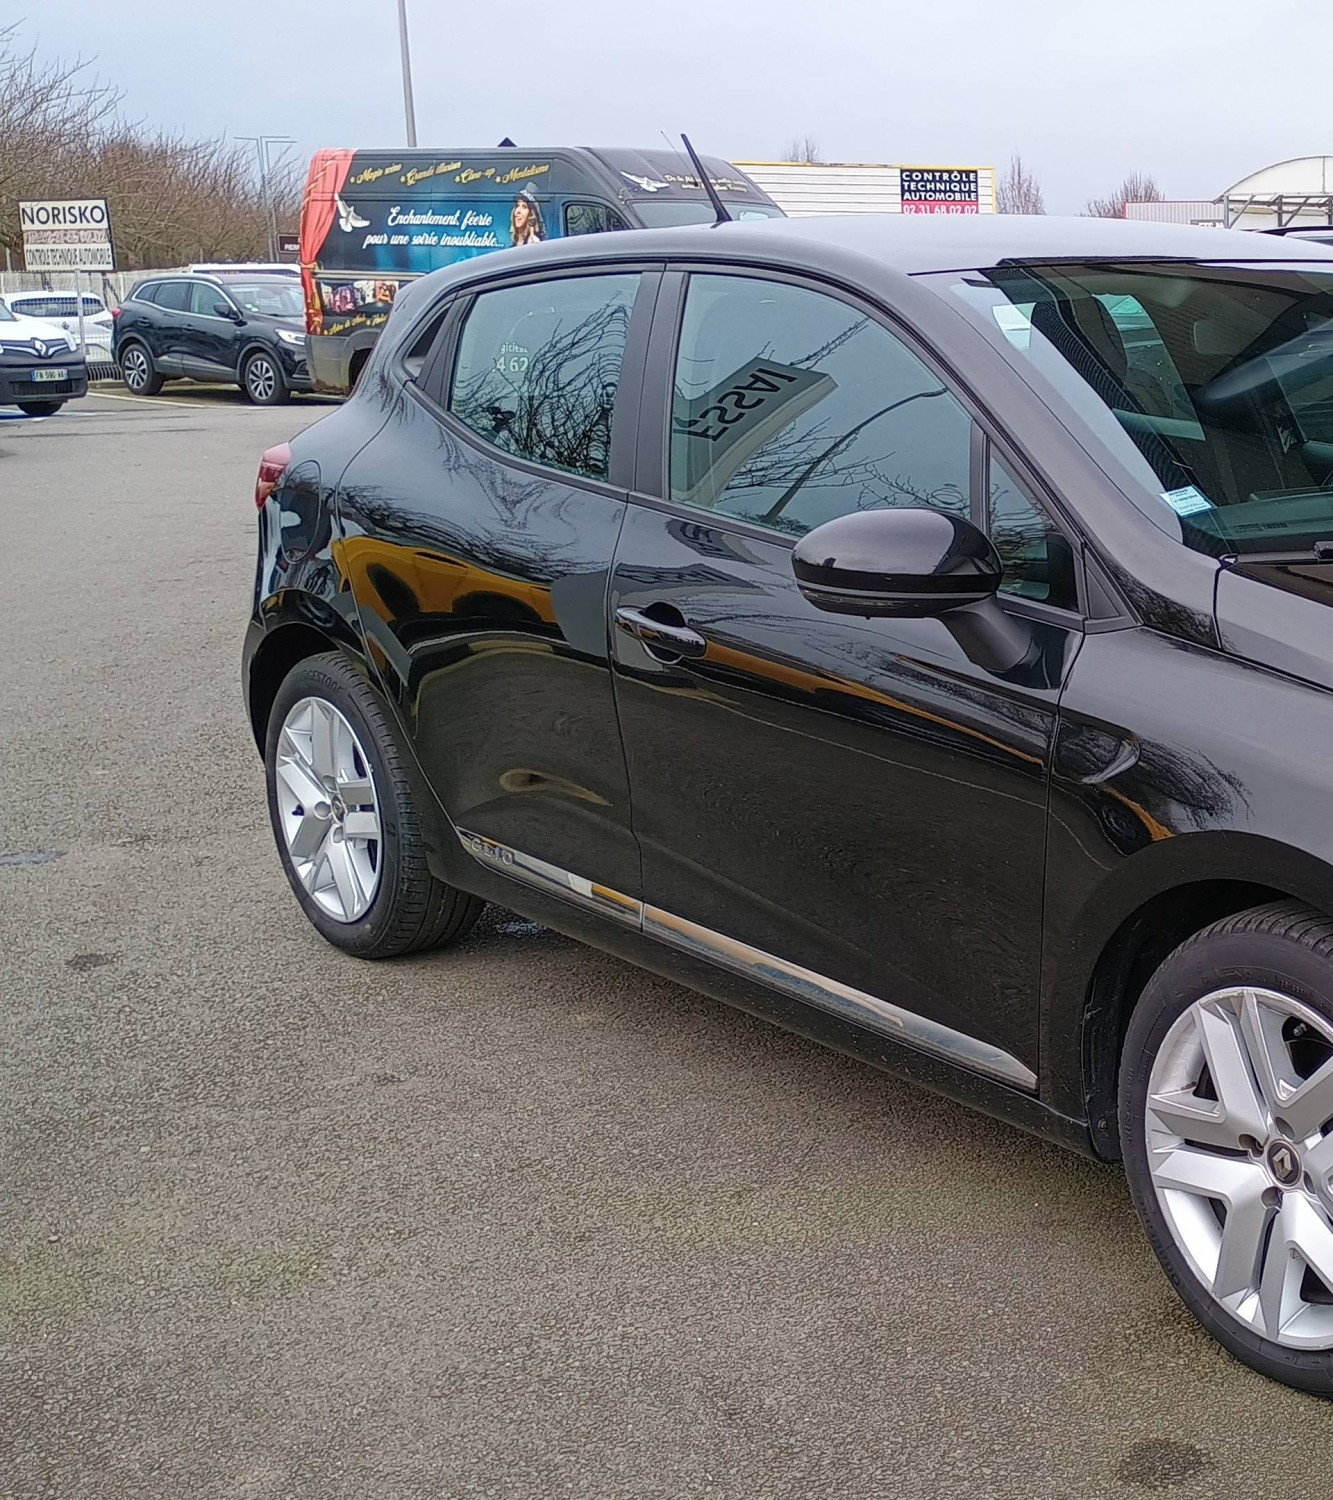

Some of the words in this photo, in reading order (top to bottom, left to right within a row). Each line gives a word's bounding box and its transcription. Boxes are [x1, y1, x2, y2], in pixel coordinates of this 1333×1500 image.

[356, 168, 383, 184] Magie
[460, 167, 496, 183] Close-up
[502, 164, 549, 184] Mentalisme
[902, 171, 976, 181] CONTRÔLE
[902, 182, 977, 192] TECHNIQUE
[903, 192, 977, 201] AUTOMOBILE
[21, 205, 105, 225] NORISKO
[461, 209, 493, 230] féerie
[362, 233, 388, 249] pour
[390, 234, 409, 245] une
[411, 231, 439, 246] soirée
[440, 231, 504, 247] inoubliable...
